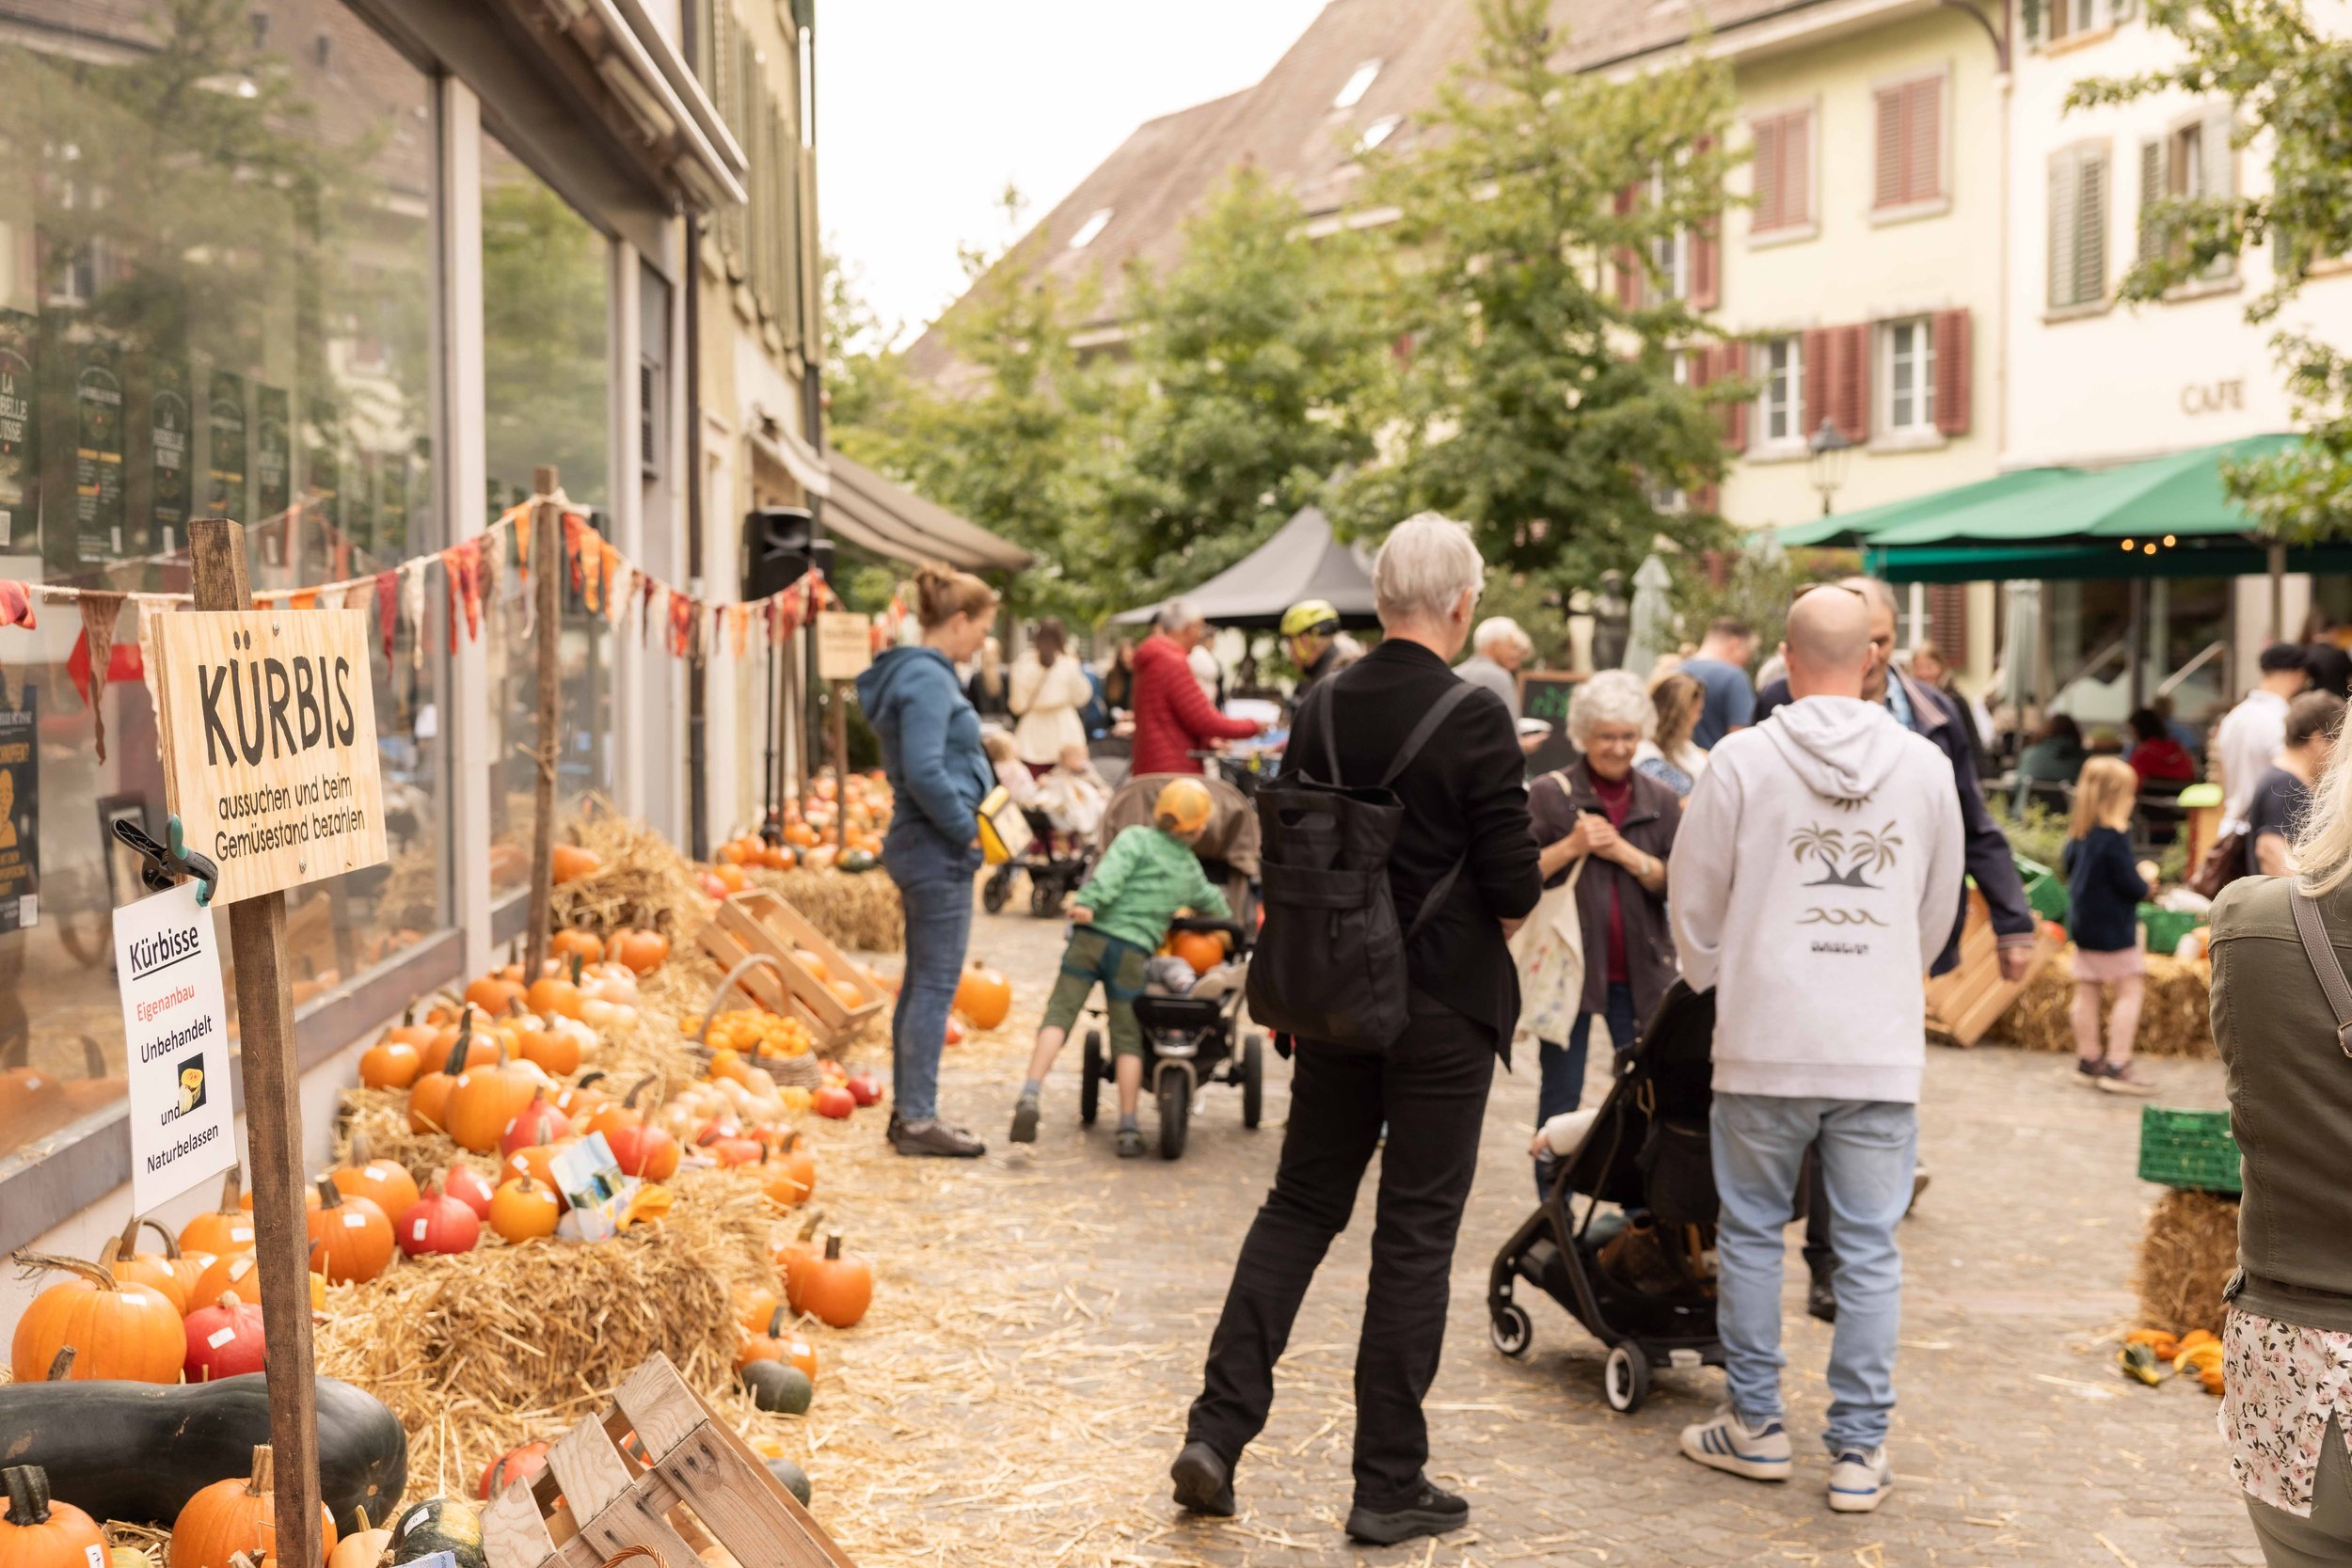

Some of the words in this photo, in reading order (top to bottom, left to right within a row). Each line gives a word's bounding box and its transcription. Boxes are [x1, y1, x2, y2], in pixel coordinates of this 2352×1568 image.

[198, 629, 355, 768] KÜRBIS
[218, 783, 291, 820] aussuchen
[295, 775, 319, 807] und
[323, 771, 352, 800] beim
[215, 812, 309, 862] Gemüsestand
[314, 805, 365, 839] bezahlen
[129, 926, 199, 974] Kürbisse
[136, 984, 195, 1023] Eigenanbau
[140, 1014, 213, 1064] Unbehandelt
[161, 1100, 181, 1127] und
[147, 1122, 218, 1174] Naturbelassen
